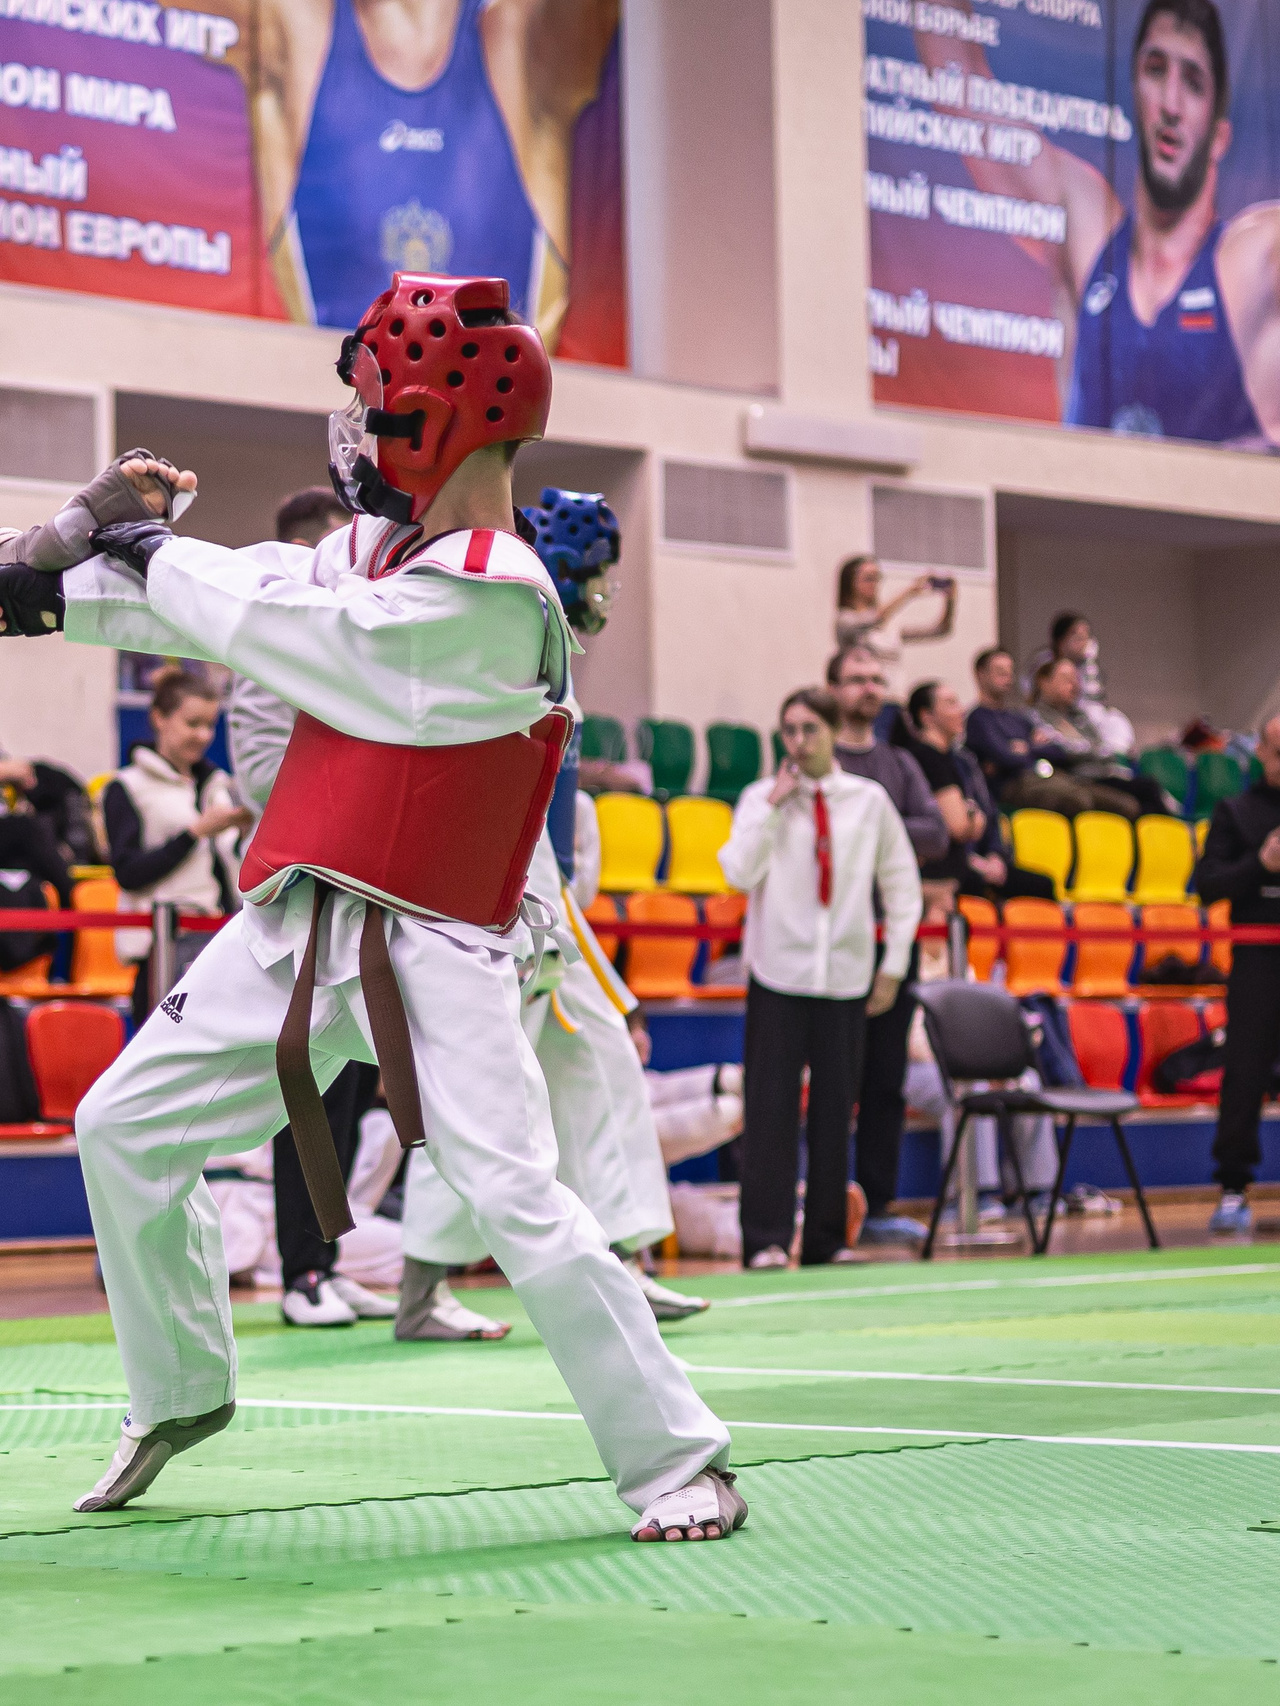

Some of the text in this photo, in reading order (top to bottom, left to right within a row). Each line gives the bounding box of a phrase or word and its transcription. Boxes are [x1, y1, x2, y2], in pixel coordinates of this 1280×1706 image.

[164, 7, 239, 59] ИГР
[64, 72, 178, 133] МИРА
[968, 73, 1132, 142] ПОБЕДИТЕЛЬ
[987, 125, 1044, 166] ИГР
[65, 208, 232, 276] ЕВРОПЫ
[932, 183, 1067, 245] ЧЕМПИОН
[932, 299, 1065, 359] ЧЕМПИОН
